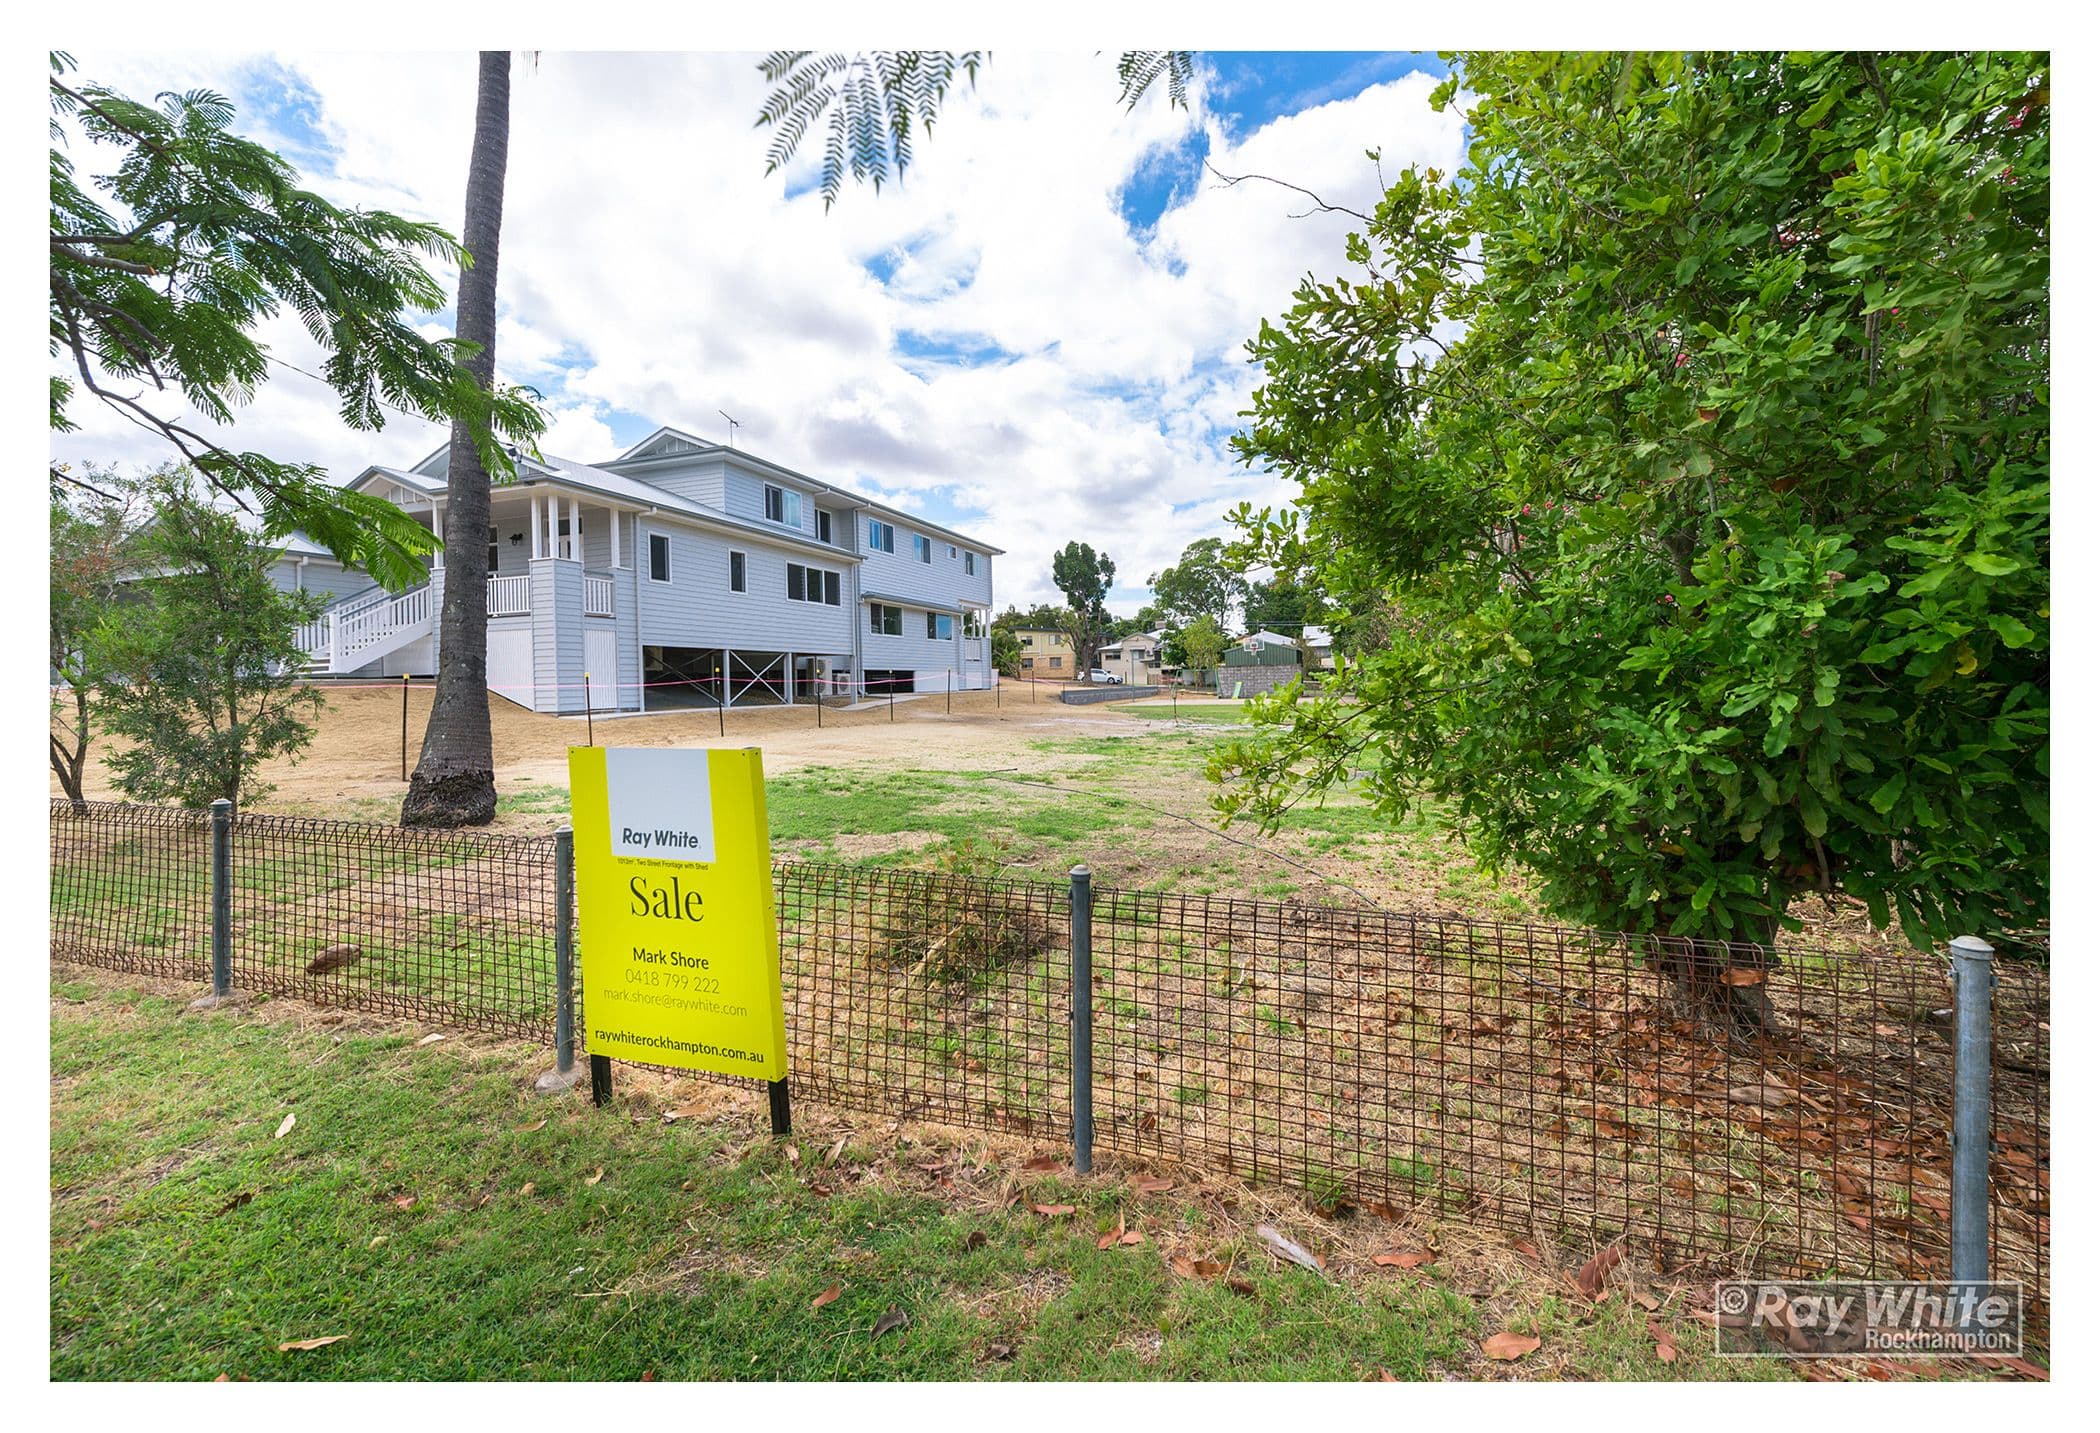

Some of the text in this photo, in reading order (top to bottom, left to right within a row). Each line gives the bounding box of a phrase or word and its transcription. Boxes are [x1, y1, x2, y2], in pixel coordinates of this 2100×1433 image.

[622, 828, 699, 849] Ray White
[630, 876, 704, 922] Sale
[633, 947, 709, 969] Mark Shore
[625, 968, 720, 994] 0418 799 222
[603, 987, 747, 1017] mark.shore@raywhite.com
[595, 1028, 764, 1063] raywhiterockhampton.com.au
